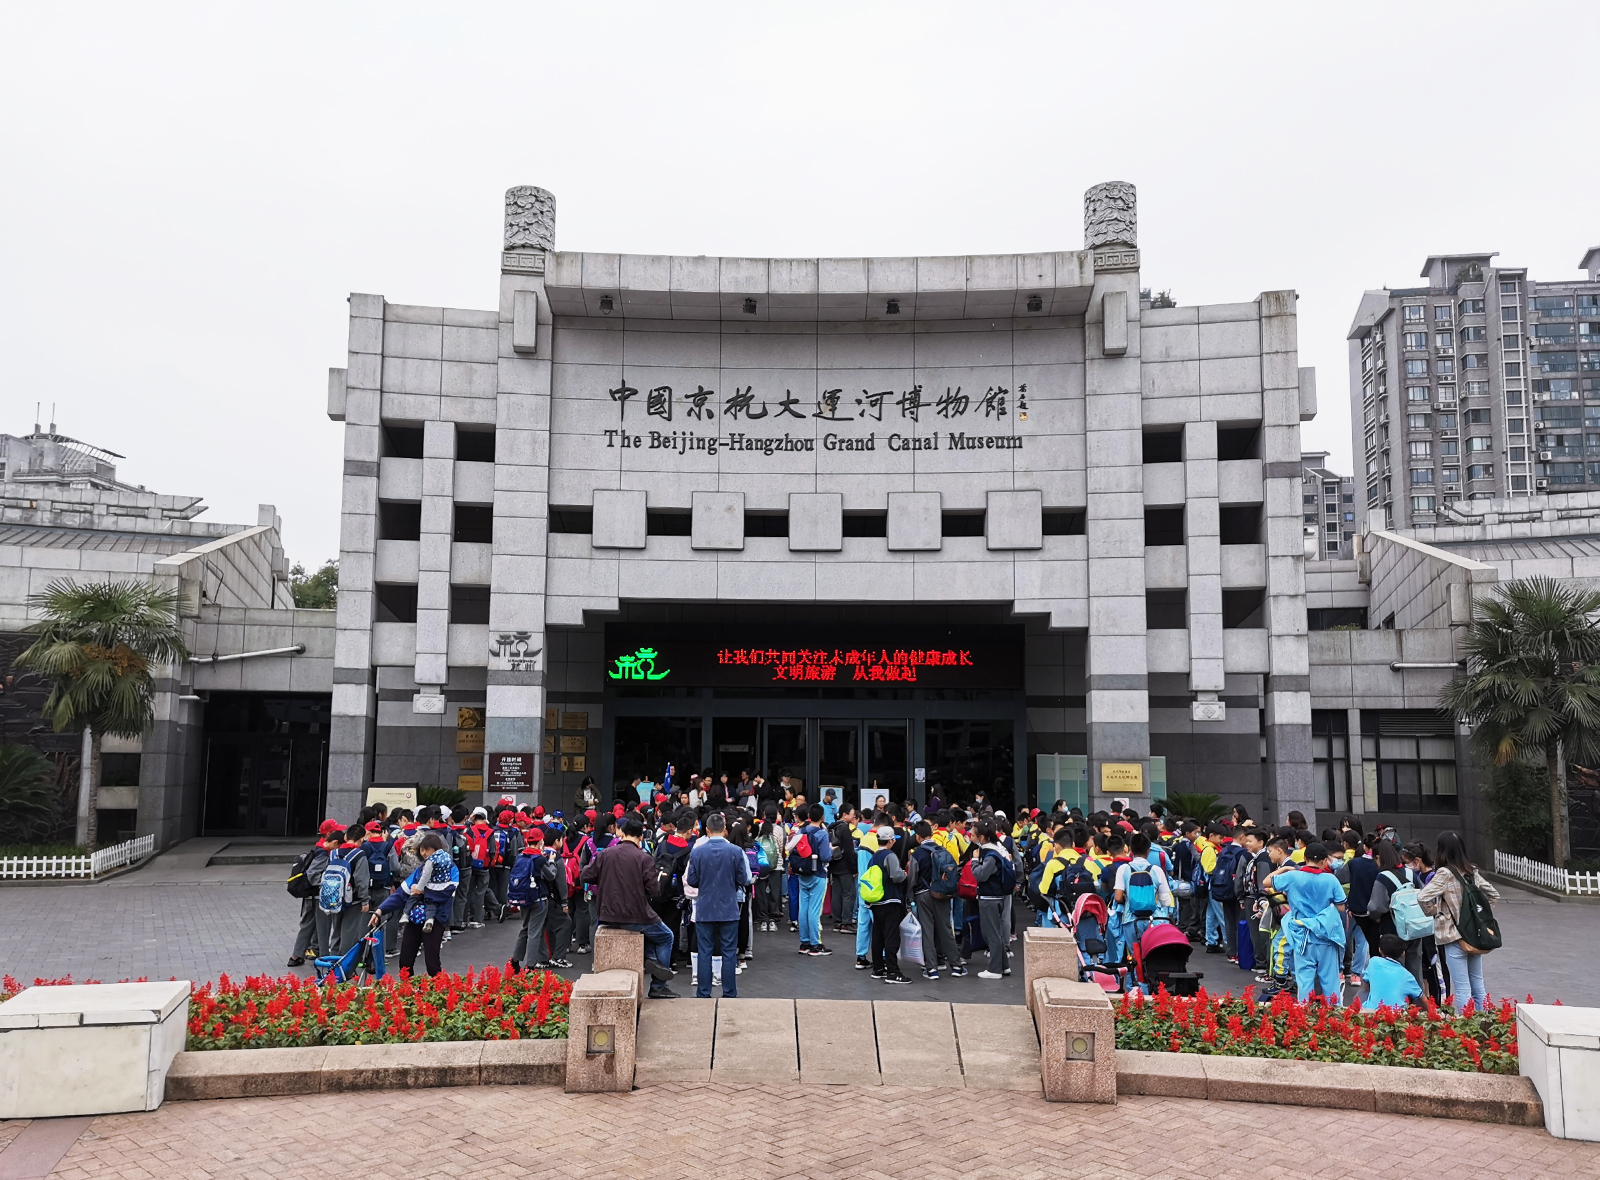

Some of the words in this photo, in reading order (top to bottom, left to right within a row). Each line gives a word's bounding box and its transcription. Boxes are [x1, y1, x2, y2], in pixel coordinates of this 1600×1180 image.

[604, 430, 641, 448] The
[649, 431, 814, 455] Beijing-Hangzhou
[824, 433, 875, 451] Grand
[888, 432, 938, 451] Canal
[949, 432, 1023, 450] Museum
[716, 648, 974, 667] 让我们共同关注未成年人的健康成长
[772, 665, 836, 681] 文明旅游
[852, 665, 917, 681] 从我做起
